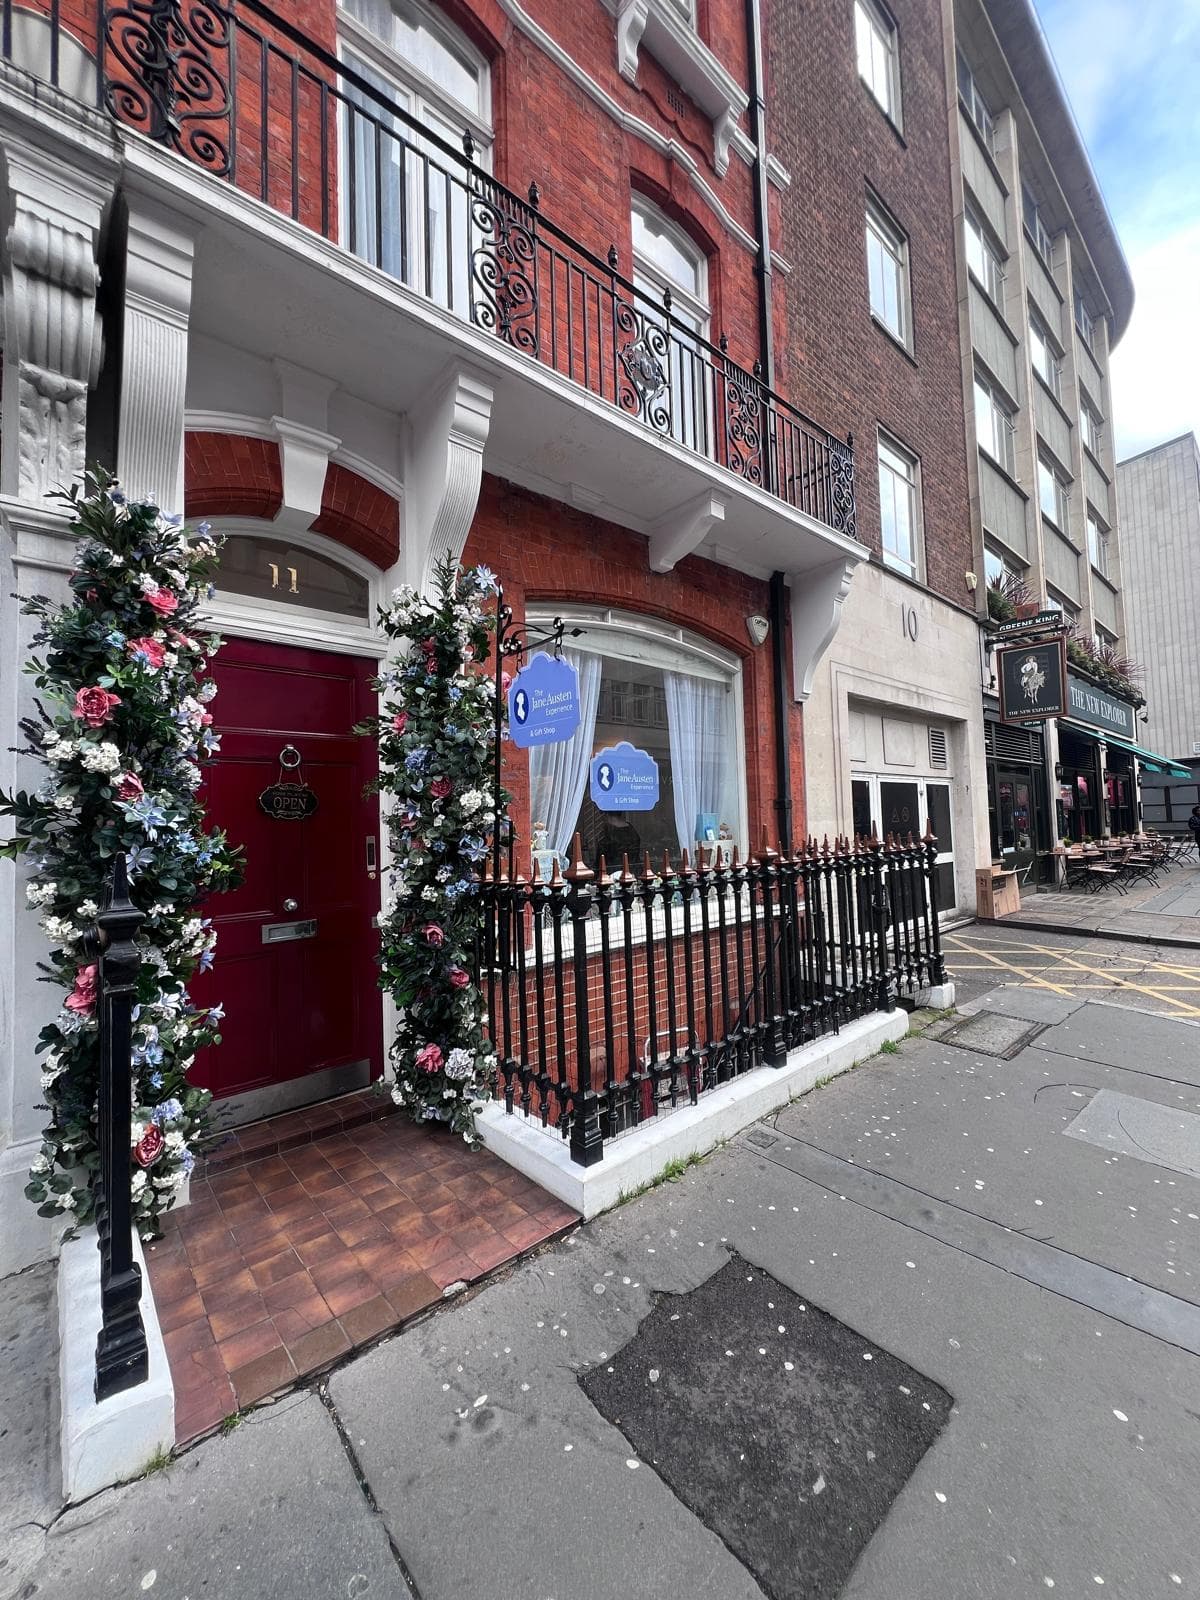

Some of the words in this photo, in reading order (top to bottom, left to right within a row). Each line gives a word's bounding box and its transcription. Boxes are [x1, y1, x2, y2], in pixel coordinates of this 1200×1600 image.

[268, 563, 300, 593] 11
[901, 602, 918, 642] 10
[999, 620, 1034, 631] GREENE
[1035, 614, 1060, 624] KING
[545, 704, 574, 717] Experience
[1031, 705, 1060, 713] EXPLORER
[1070, 686, 1086, 710] THE
[1086, 693, 1100, 715] NEW
[1100, 700, 1127, 727] EXPLORER
[534, 728, 543, 736] Gift
[543, 727, 556, 736] Shop
[273, 796, 307, 810] OPEN
